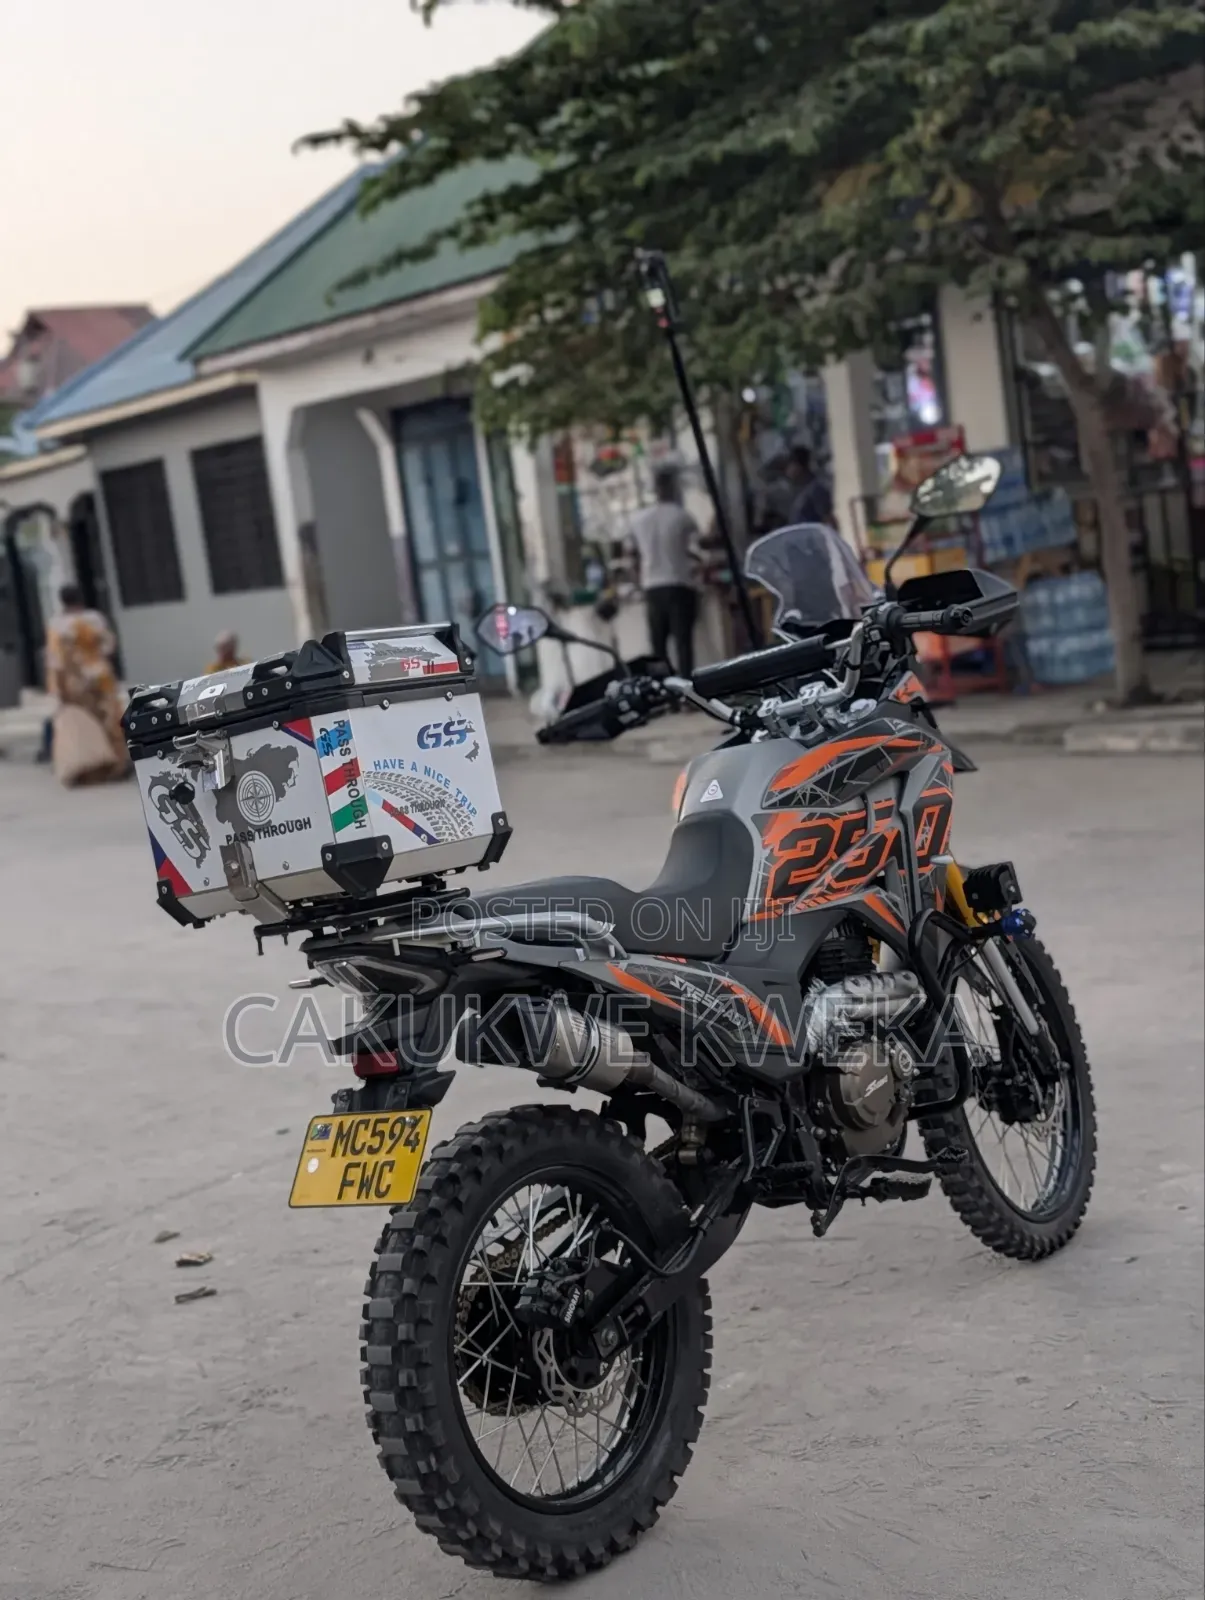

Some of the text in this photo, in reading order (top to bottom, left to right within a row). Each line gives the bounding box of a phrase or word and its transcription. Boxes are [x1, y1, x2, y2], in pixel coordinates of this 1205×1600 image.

[319, 727, 335, 757] GS
[416, 718, 468, 750] GS
[333, 720, 367, 829] PASS THROUGH
[373, 758, 478, 818] HAVE A NICE TRIP
[226, 816, 312, 845] PASS THROUGH
[766, 786, 953, 899] 250
[331, 1115, 424, 1158] MC594
[337, 1160, 395, 1201] FWC
